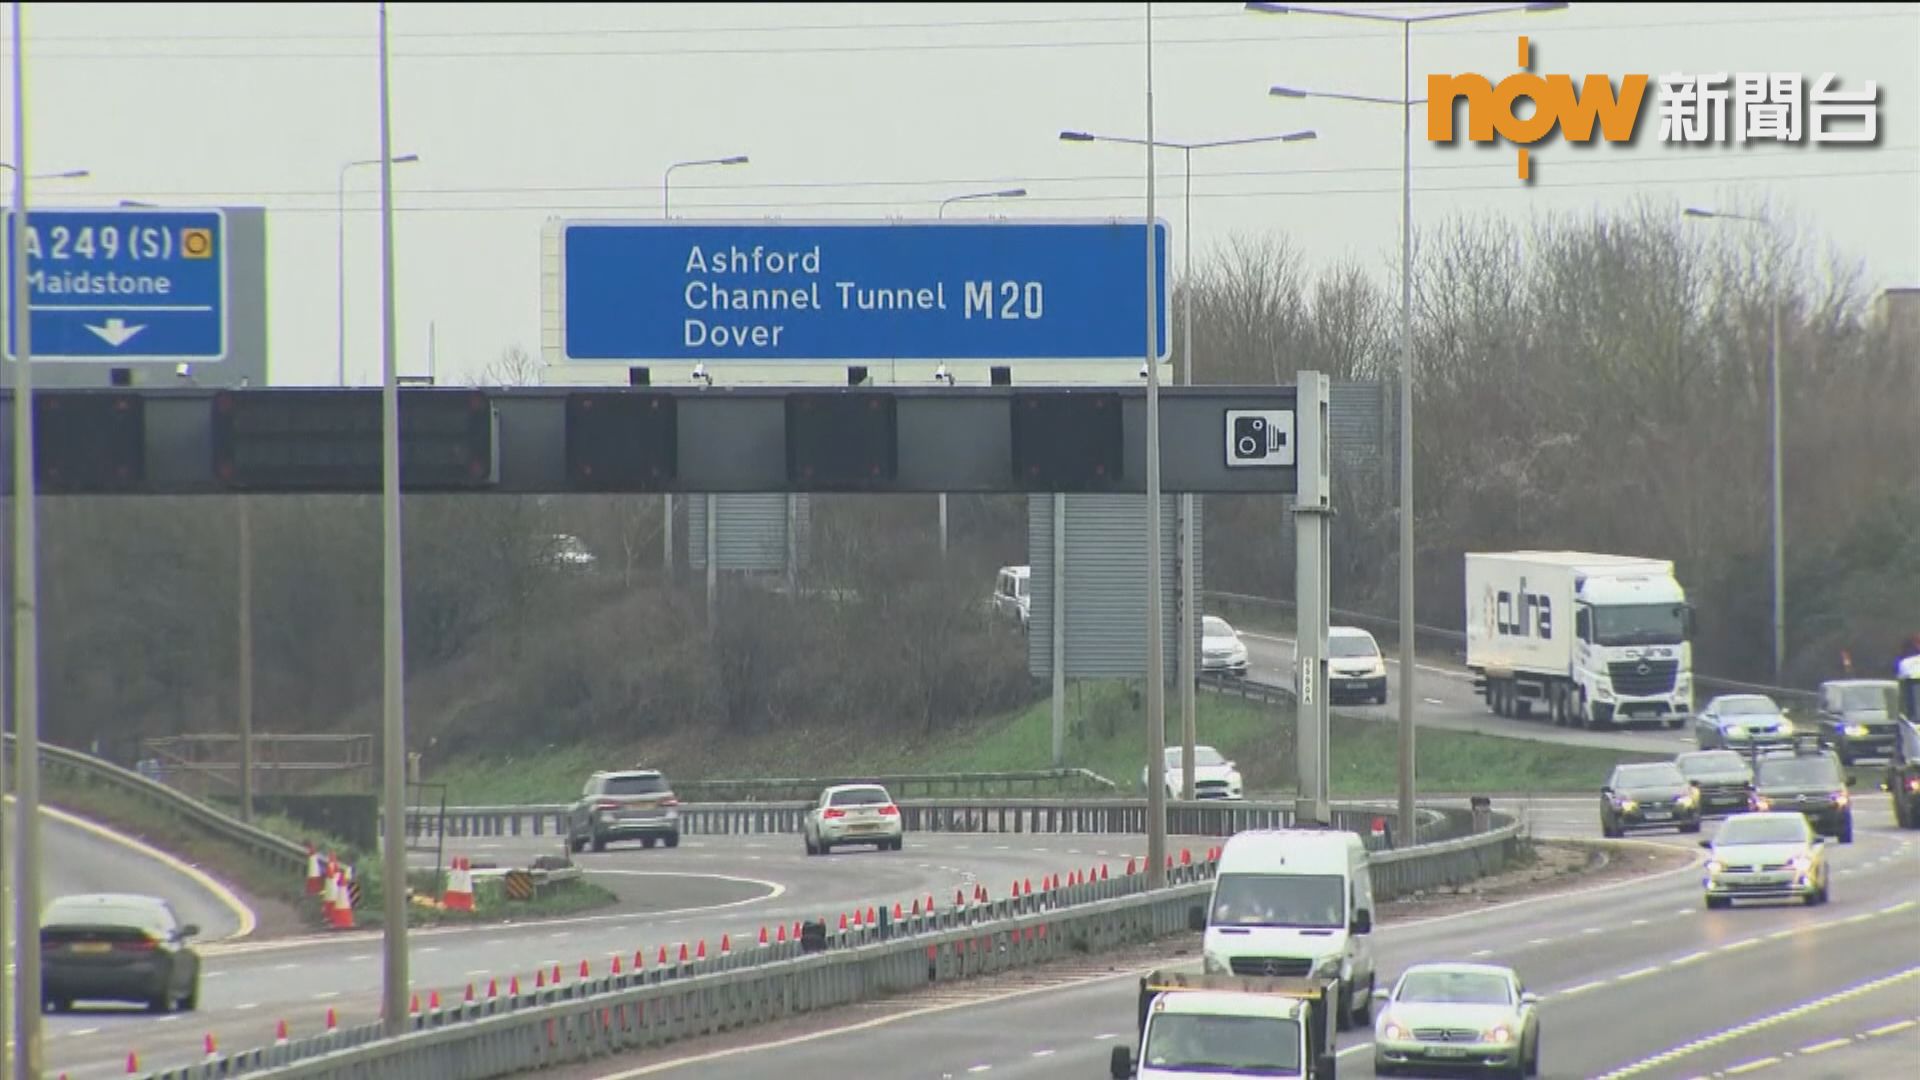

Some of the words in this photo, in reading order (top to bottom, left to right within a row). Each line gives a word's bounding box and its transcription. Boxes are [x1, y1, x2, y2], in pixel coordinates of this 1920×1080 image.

[129, 226, 172, 259] (S)
[686, 246, 820, 273] Ashford
[685, 281, 821, 310] Channel
[836, 282, 947, 310] Tunnel
[965, 281, 1044, 319] M20
[685, 320, 783, 346] Dover
